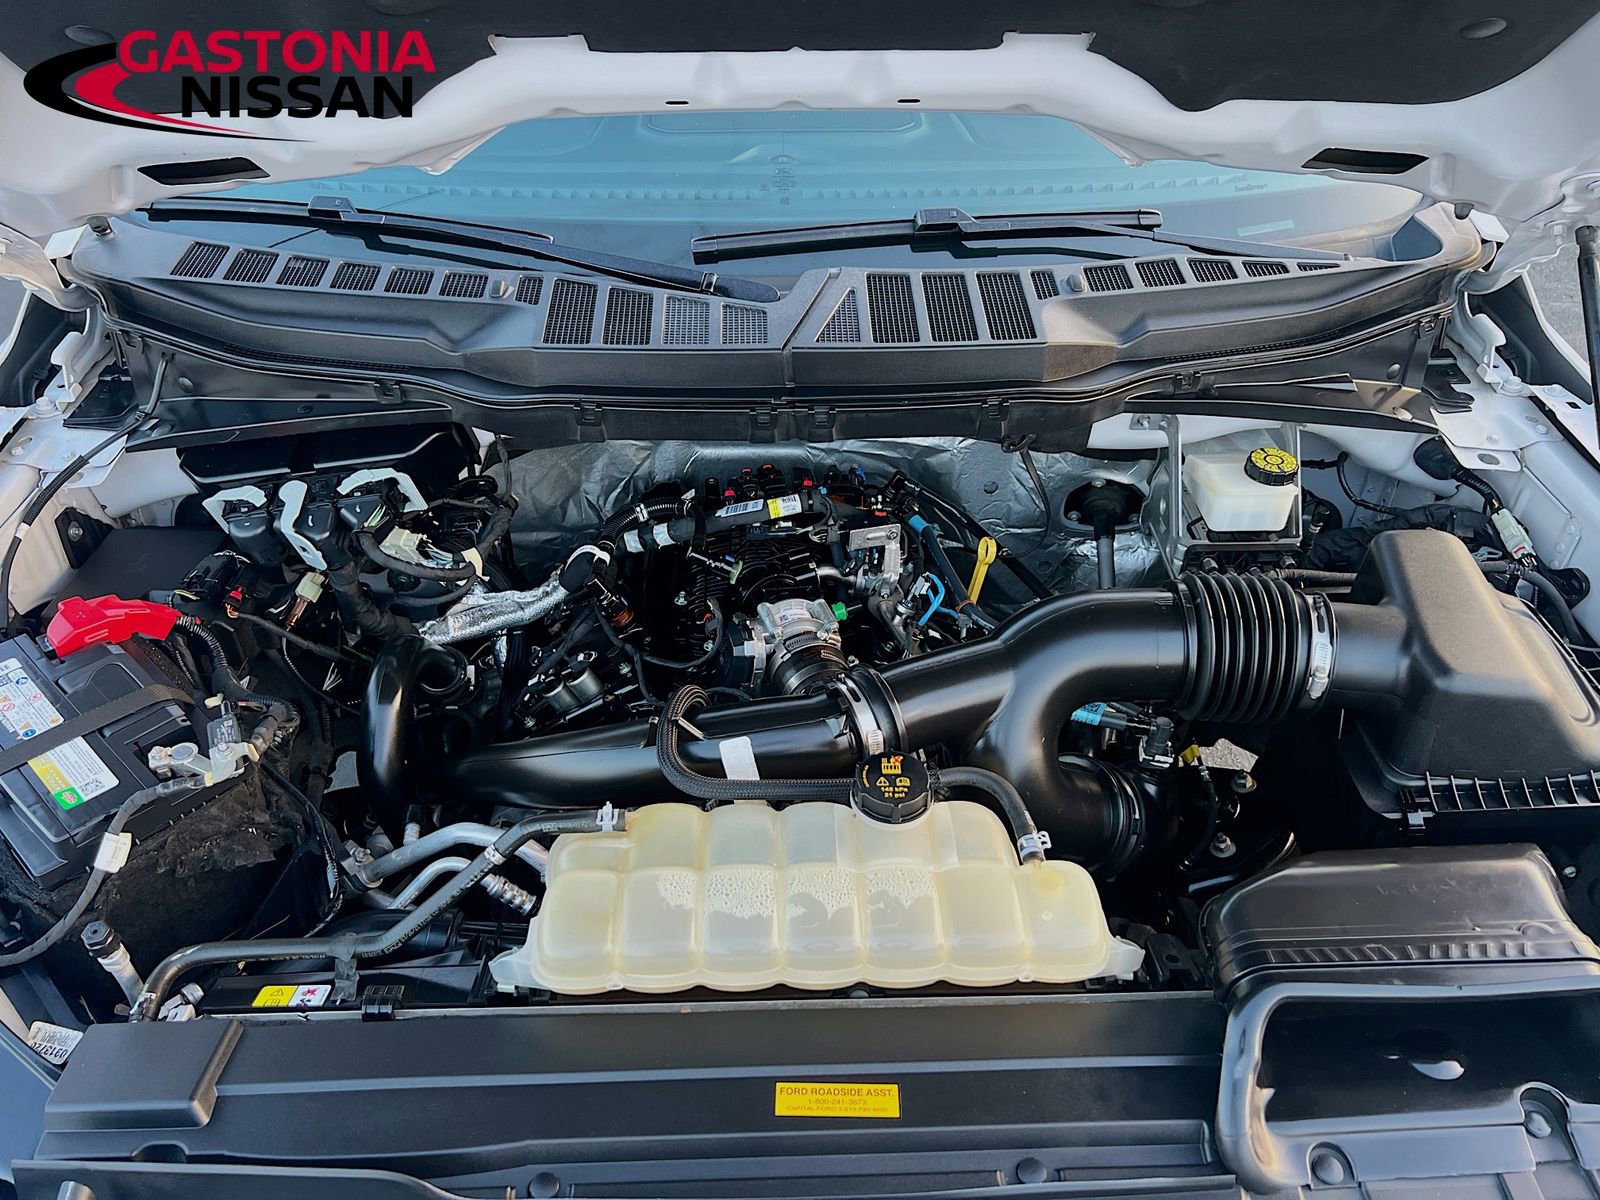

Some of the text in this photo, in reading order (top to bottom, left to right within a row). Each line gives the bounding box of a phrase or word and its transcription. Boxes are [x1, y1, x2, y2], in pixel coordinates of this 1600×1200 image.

[780, 1086, 895, 1097] FORD ROADSIDE ASST.
